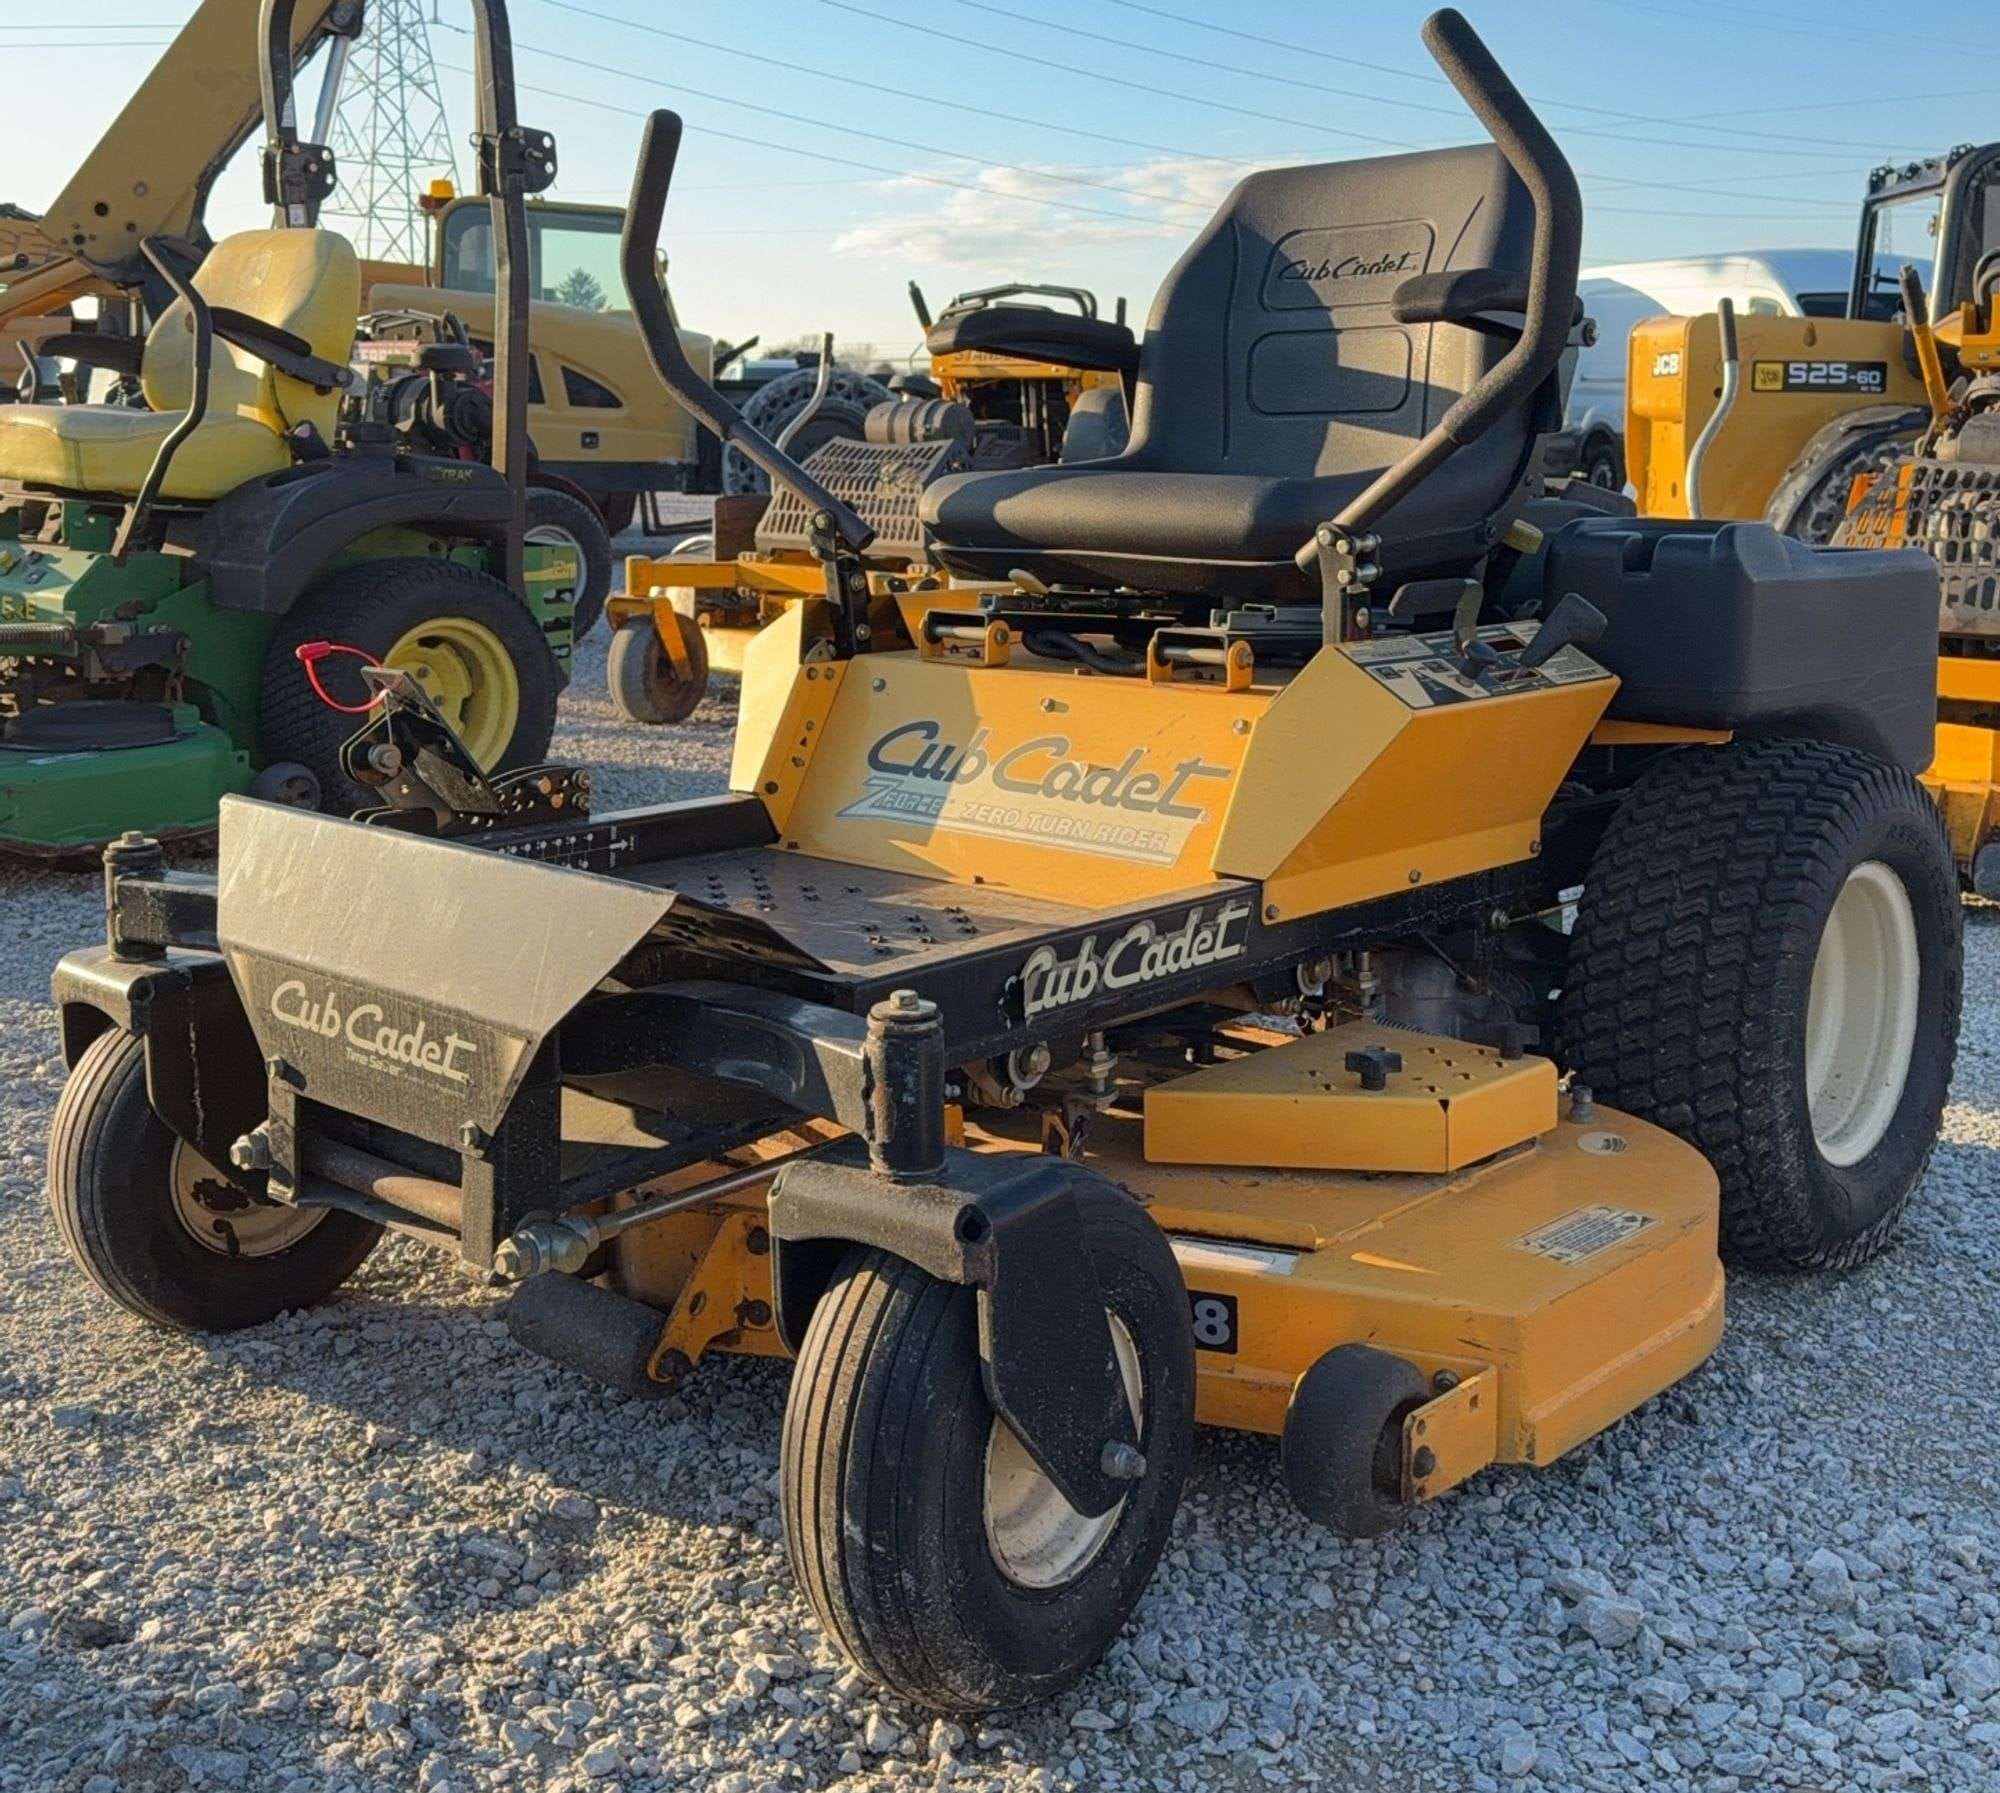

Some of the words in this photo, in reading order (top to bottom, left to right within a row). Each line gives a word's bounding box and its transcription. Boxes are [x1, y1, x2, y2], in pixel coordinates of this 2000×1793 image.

[1279, 258, 1331, 281] Cub
[1332, 251, 1421, 280] Cadet
[1652, 353, 1680, 376] JCB
[1788, 363, 1882, 384] 525-60
[867, 719, 989, 784] Cub
[992, 734, 1232, 820] Cadet
[962, 802, 1021, 825] ZERO
[1024, 811, 1093, 841] TURN
[1091, 823, 1169, 852] RIDER
[1102, 899, 1250, 990] Cadet
[271, 979, 341, 1038] Cub
[345, 1003, 477, 1085] Cadet
